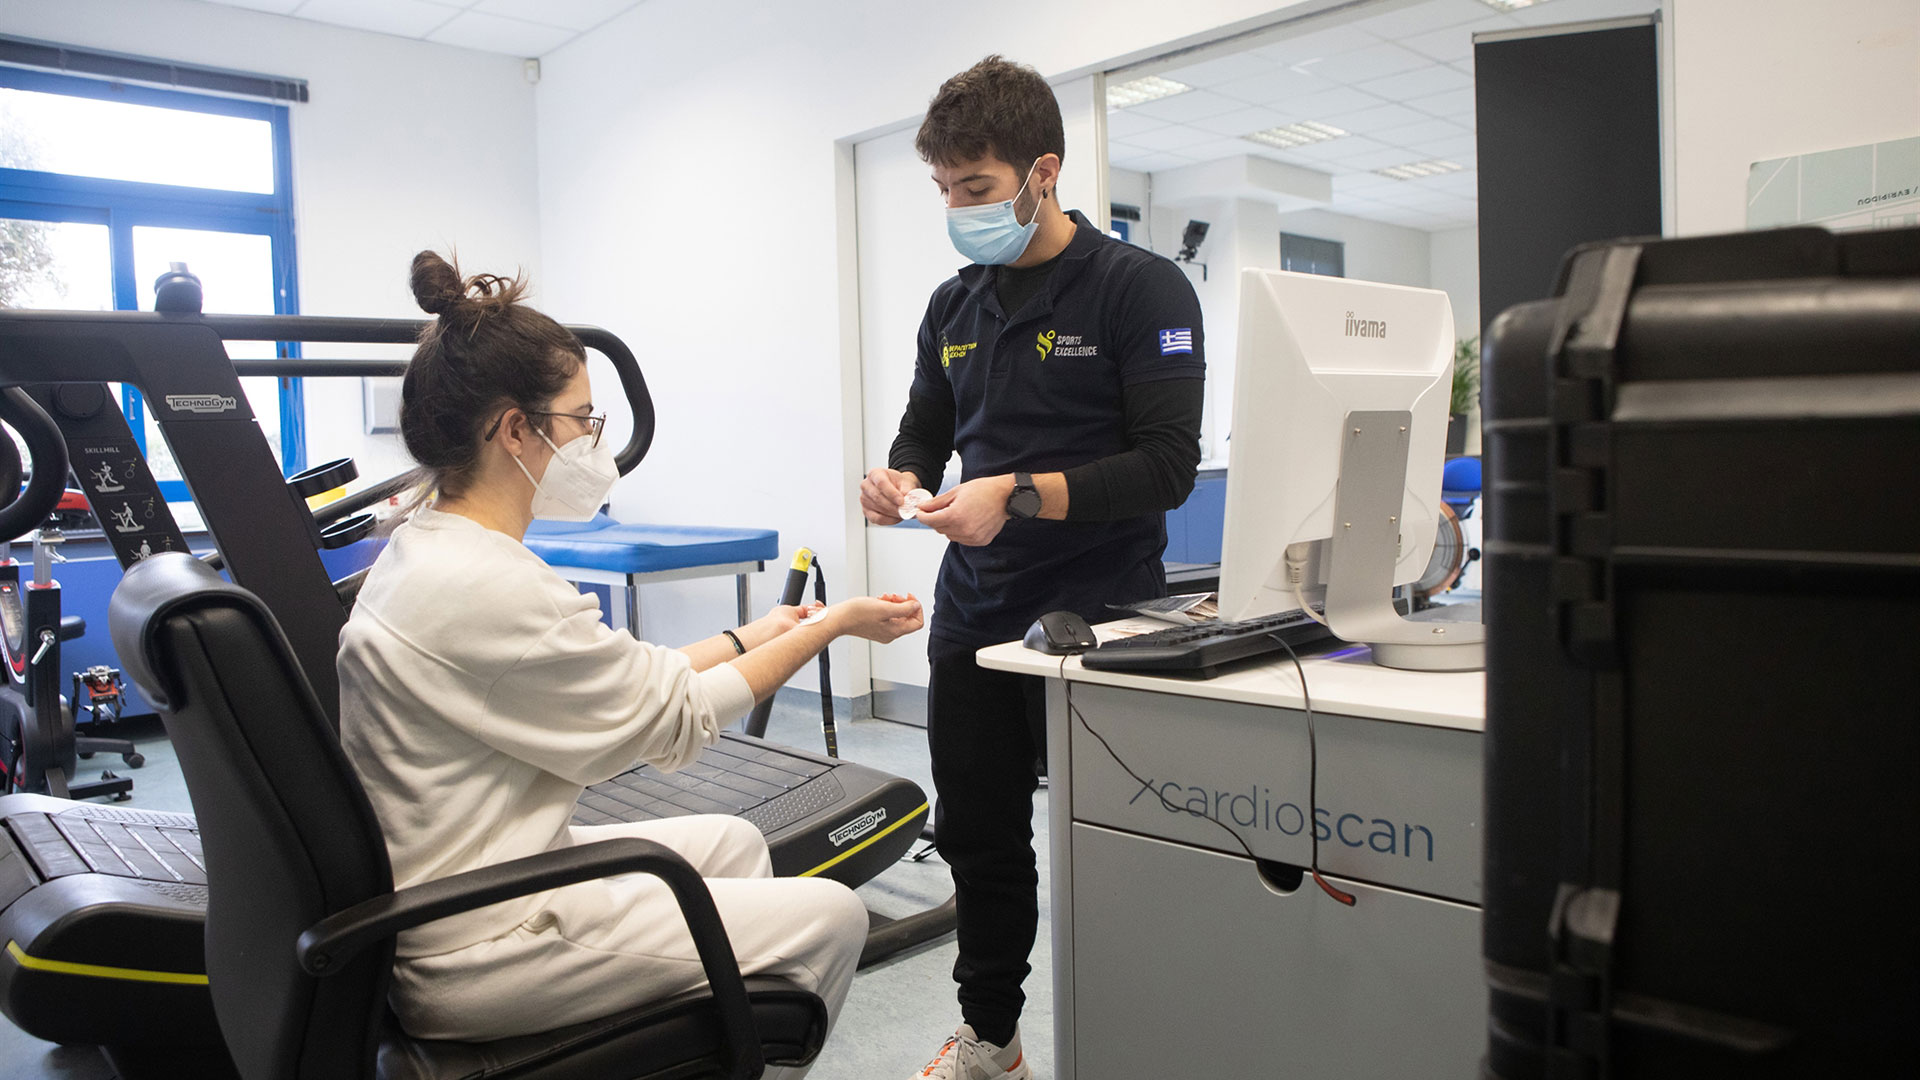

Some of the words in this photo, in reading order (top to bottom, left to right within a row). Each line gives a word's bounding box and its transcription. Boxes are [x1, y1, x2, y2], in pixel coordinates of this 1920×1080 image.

[1857, 188, 1910, 205] EVRIPIDOU
[1345, 310, 1386, 339] iiyama
[1056, 335, 1082, 345] SPORTS
[1054, 345, 1098, 357] EXCELLENCE
[84, 446, 120, 454] SKILLMILL
[1159, 781, 1434, 862] cardioscan
